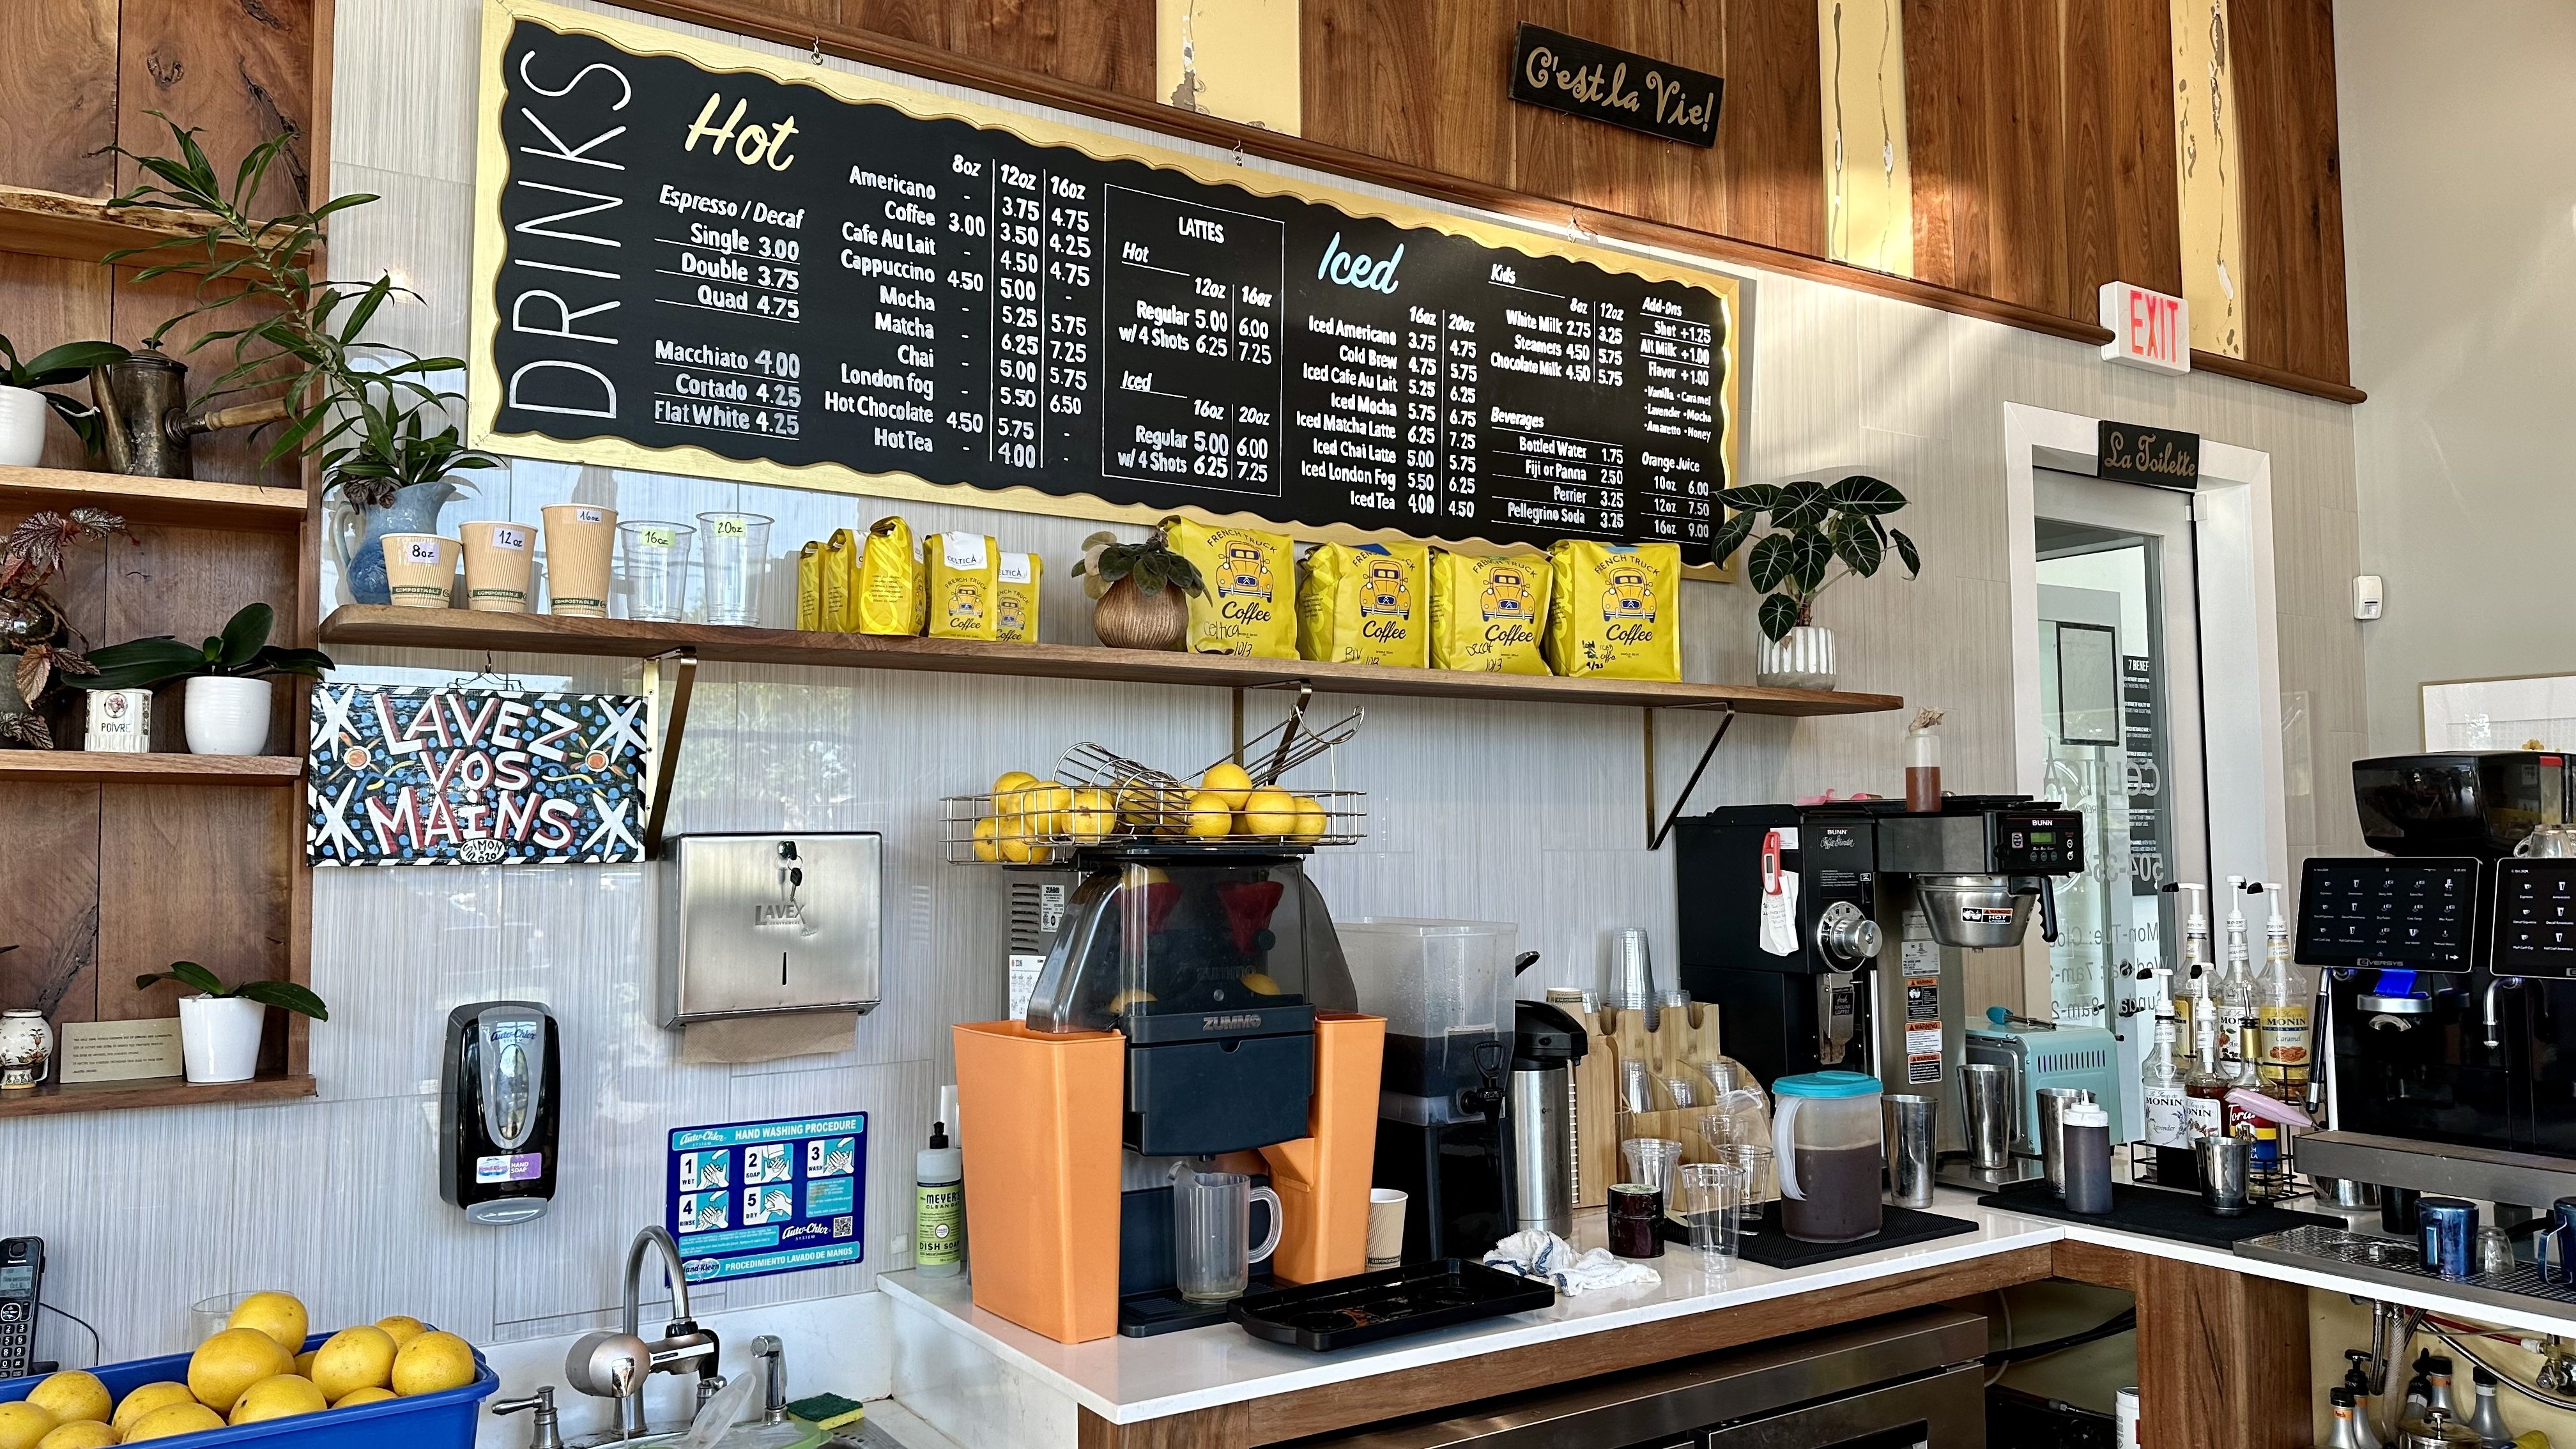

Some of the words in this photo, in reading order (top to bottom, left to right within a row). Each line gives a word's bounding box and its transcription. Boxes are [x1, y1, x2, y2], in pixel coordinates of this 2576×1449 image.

[1526, 47, 1604, 103] C'est
[1602, 63, 1639, 112] la
[1646, 70, 1713, 132] Vie!
[685, 93, 799, 171] Hot
[953, 155, 981, 176] 8oz
[1001, 164, 1036, 190] 12oz
[1050, 176, 1085, 200] 16oz
[659, 185, 737, 217] Espresso
[753, 203, 805, 229] Decaf
[849, 165, 935, 199] Americano
[1002, 197, 1039, 221] 3.75
[1052, 208, 1089, 232] 4.75
[509, 50, 631, 418] DRINKS
[885, 201, 935, 226] Coffee
[949, 213, 985, 236] 3.00
[1000, 223, 1038, 247] 3.50
[1050, 234, 1091, 257] 4.25
[1179, 217, 1224, 243] LATTES
[1318, 232, 1404, 294] Iced
[1491, 264, 1515, 284] Kids
[1410, 306, 1436, 326] 16oz
[1448, 314, 1475, 332] 20oz
[1570, 298, 1588, 314] 8oz
[1600, 303, 1623, 321] 12oz
[1643, 297, 1682, 316] Add-Ons
[1309, 315, 1334, 335] Iced
[1335, 320, 1396, 346] Americano
[1408, 332, 1436, 351] 3.75
[1450, 340, 1476, 358] 4.75
[1506, 310, 1537, 329] White
[1539, 316, 1563, 334] Milk
[1567, 321, 1591, 338] 2.75
[1598, 326, 1622, 344] 3.25
[1655, 321, 1676, 337] Shot
[1681, 327, 1711, 343] +1.25
[2129, 289, 2179, 364] EXIT
[656, 340, 748, 369] Macchiato
[755, 350, 800, 378] 4.00
[1340, 345, 1365, 364] Cold
[1368, 349, 1397, 369] Brew
[1409, 356, 1436, 375] 4.75
[1451, 364, 1477, 381] 5.75
[1641, 339, 1654, 353] Alt
[1655, 341, 1677, 356] Milk
[1682, 348, 1709, 365] +1.00
[676, 374, 747, 401] Cortado
[756, 383, 801, 408] 4.25
[1122, 370, 1152, 392] Iced
[1491, 407, 1544, 430] Beverages
[1136, 425, 1188, 450] Regular
[1194, 431, 1229, 456] 5.00
[1237, 437, 1268, 459] 6.00
[1520, 436, 1555, 454] Bottled
[1556, 441, 1586, 458] Water
[1602, 448, 1623, 464] 1.75
[2104, 431, 2132, 469] La
[2135, 433, 2196, 477] Toilette
[1118, 448, 1136, 468] w/
[1138, 451, 1147, 468] 4
[1150, 452, 1186, 473] Shots
[1194, 455, 1228, 478] 6.25
[1237, 461, 1267, 482] 7.25
[1642, 452, 1675, 472] Orange
[1676, 457, 1699, 472] Juice
[1654, 476, 1676, 491] 10oz
[1689, 480, 1708, 496] 6.00
[718, 521, 744, 534] 20oz
[1508, 502, 1559, 524] Pellegrino
[1561, 509, 1584, 524] Soda
[1600, 512, 1623, 528] 3.25
[1207, 528, 1243, 548] FRENCH
[1244, 533, 1278, 554] TRUCK
[1655, 520, 1676, 534] 16oz
[1689, 523, 1708, 537] 9.00
[1629, 555, 1661, 577] TRUCK
[945, 578, 967, 588] FRENCH
[970, 578, 987, 591] TRUCK
[950, 618, 981, 631] Coffee
[1222, 601, 1271, 625] Coffee
[1363, 620, 1407, 644] Coffee
[1485, 624, 1534, 647] Coffee
[1606, 624, 1652, 646] Coffee
[372, 693, 581, 762] LAVEZ
[419, 749, 532, 793] VOS
[365, 786, 581, 855] MAINS
[755, 904, 805, 926] LAVEX
[1203, 1013, 1262, 1032] ZUMMO
[2267, 1018, 2306, 1026] MONIN
[2145, 1096, 2182, 1106] MONIN
[680, 1130, 724, 1146] Auto-Chlor
[735, 1128, 760, 1140] HAND
[763, 1124, 804, 1138] WASHING
[805, 1119, 857, 1134] PROCEDURE
[782, 1223, 829, 1240] Auto-Chlor
[725, 1257, 785, 1271] PROCEDIMIENTO
[786, 1253, 815, 1264] LAVADO
[815, 1251, 826, 1259] DE
[827, 1247, 853, 1257] MANOS
[920, 1242, 940, 1250] DISH
